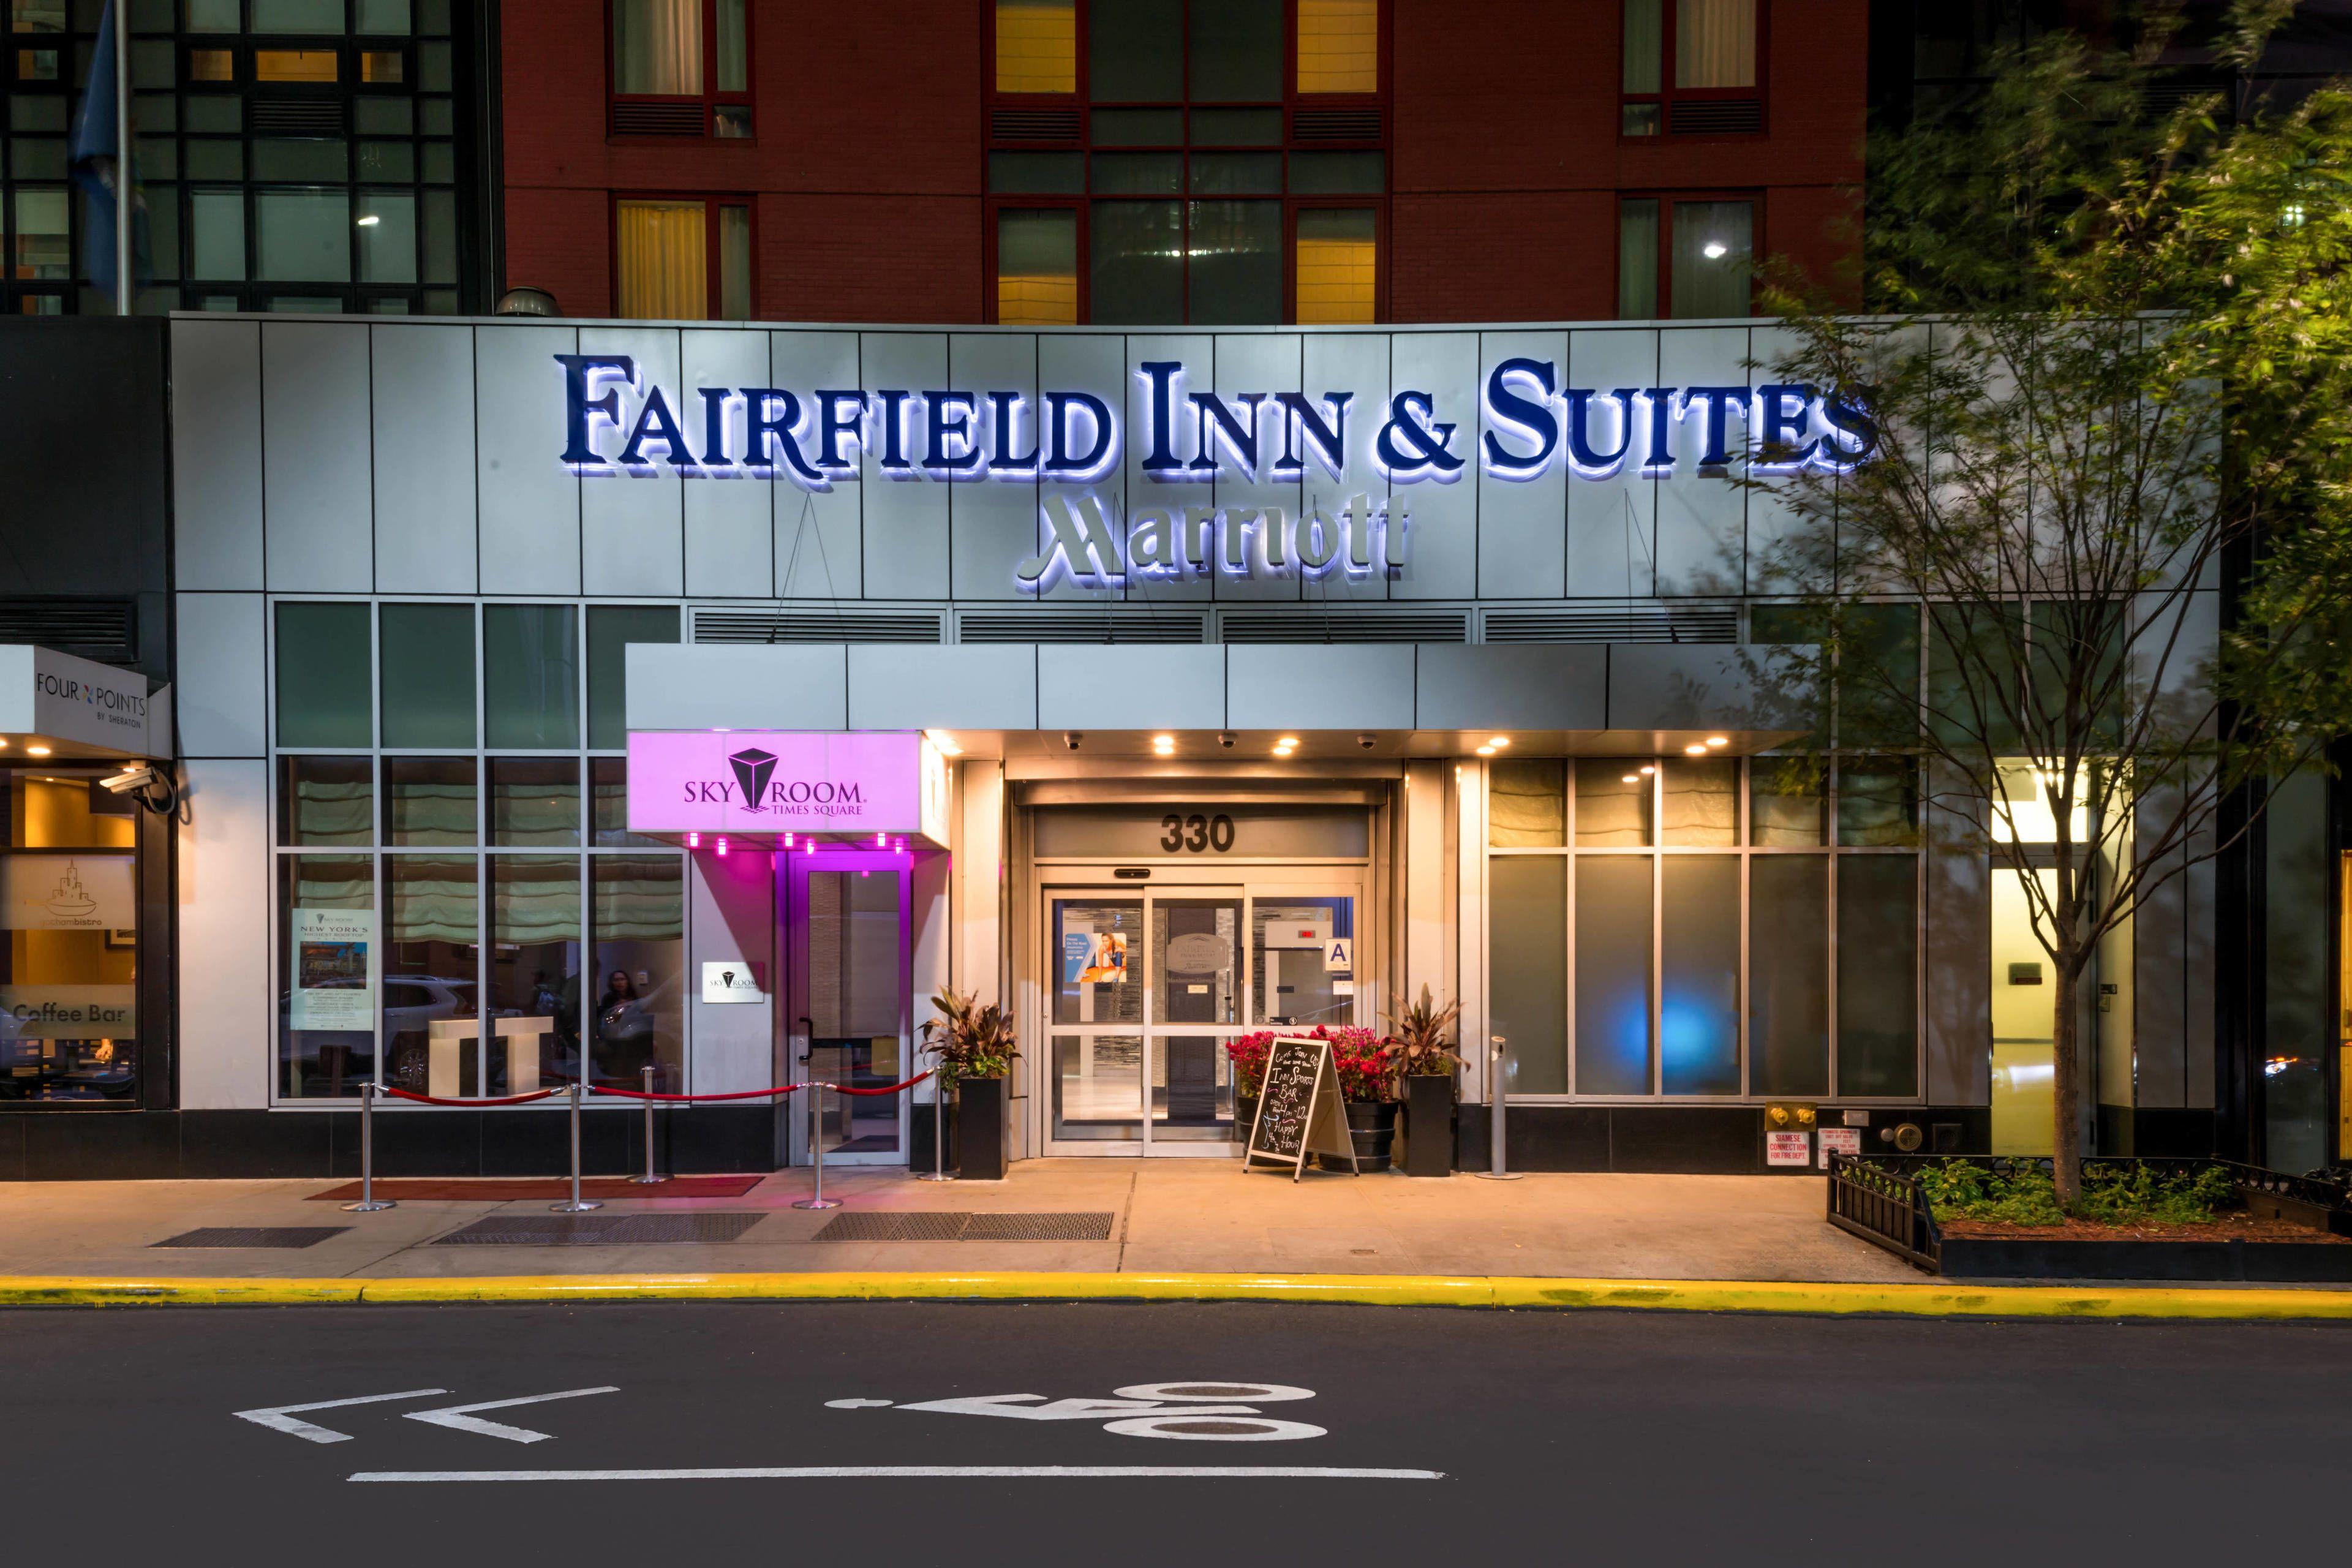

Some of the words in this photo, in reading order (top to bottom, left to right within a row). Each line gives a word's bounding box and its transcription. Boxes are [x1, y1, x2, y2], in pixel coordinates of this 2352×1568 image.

[553, 355, 1111, 480] FAIRFIELD
[1140, 361, 1354, 483] INN
[1376, 390, 1466, 470] &
[1484, 358, 1879, 469] SUITES
[1017, 492, 1409, 582] Marriott
[37, 673, 80, 700] FOUR
[96, 687, 146, 717] POINTS
[97, 712, 105, 720] BY
[109, 714, 141, 729] SHERATON
[684, 782, 736, 802] SKY
[770, 782, 862, 803] ROOM
[771, 805, 809, 815] TIMES
[813, 805, 862, 817] SQUARE
[1161, 814, 1235, 853] 330
[1330, 943, 1346, 962] A
[13, 1002, 81, 1022] Coffee
[89, 1004, 125, 1022] Bar
